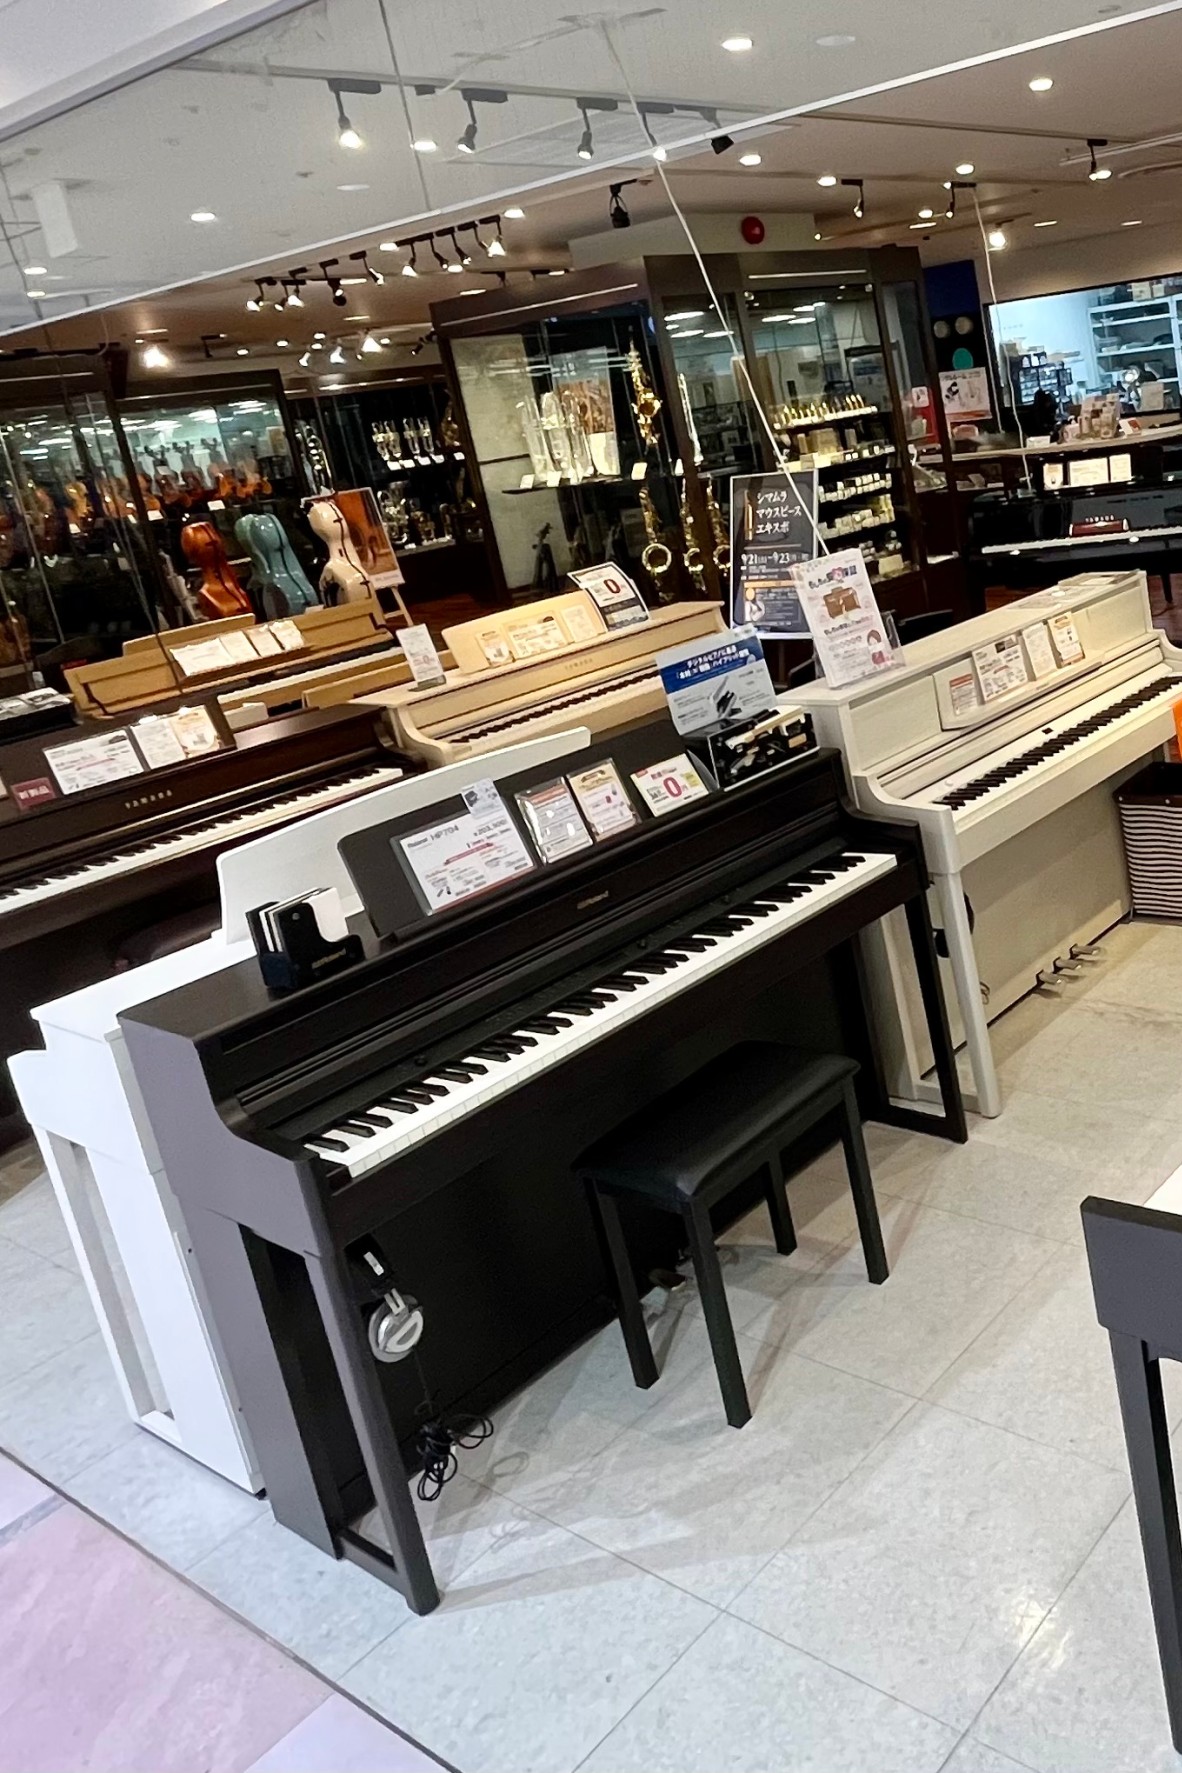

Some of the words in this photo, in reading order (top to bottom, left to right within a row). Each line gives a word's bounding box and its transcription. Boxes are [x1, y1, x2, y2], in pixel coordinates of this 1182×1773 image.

[757, 490, 787, 504] シマムラ
[756, 505, 802, 519] マウスピース
[756, 520, 790, 535] エキスポ
